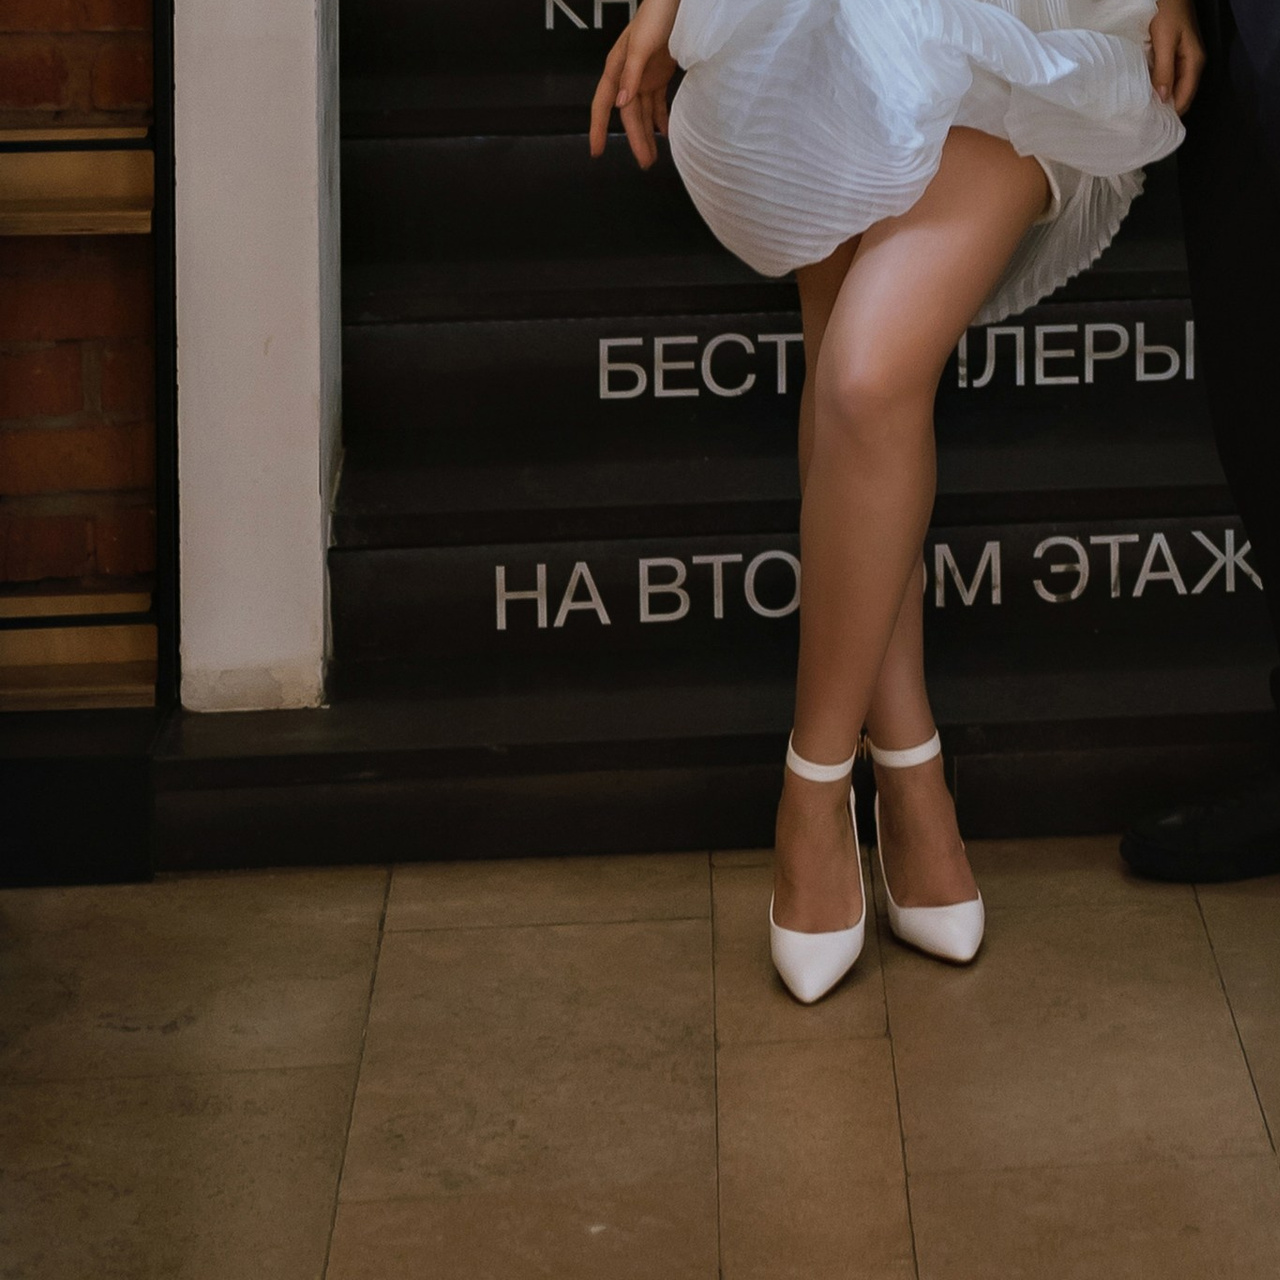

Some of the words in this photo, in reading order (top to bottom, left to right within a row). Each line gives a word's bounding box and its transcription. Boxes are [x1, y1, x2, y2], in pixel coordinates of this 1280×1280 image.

[598, 320, 1197, 402] БЕСТЛЕРЫ
[493, 558, 610, 632] НА
[638, 540, 1002, 624] ВТОМ
[1032, 528, 1264, 605] ЭТАЖ
